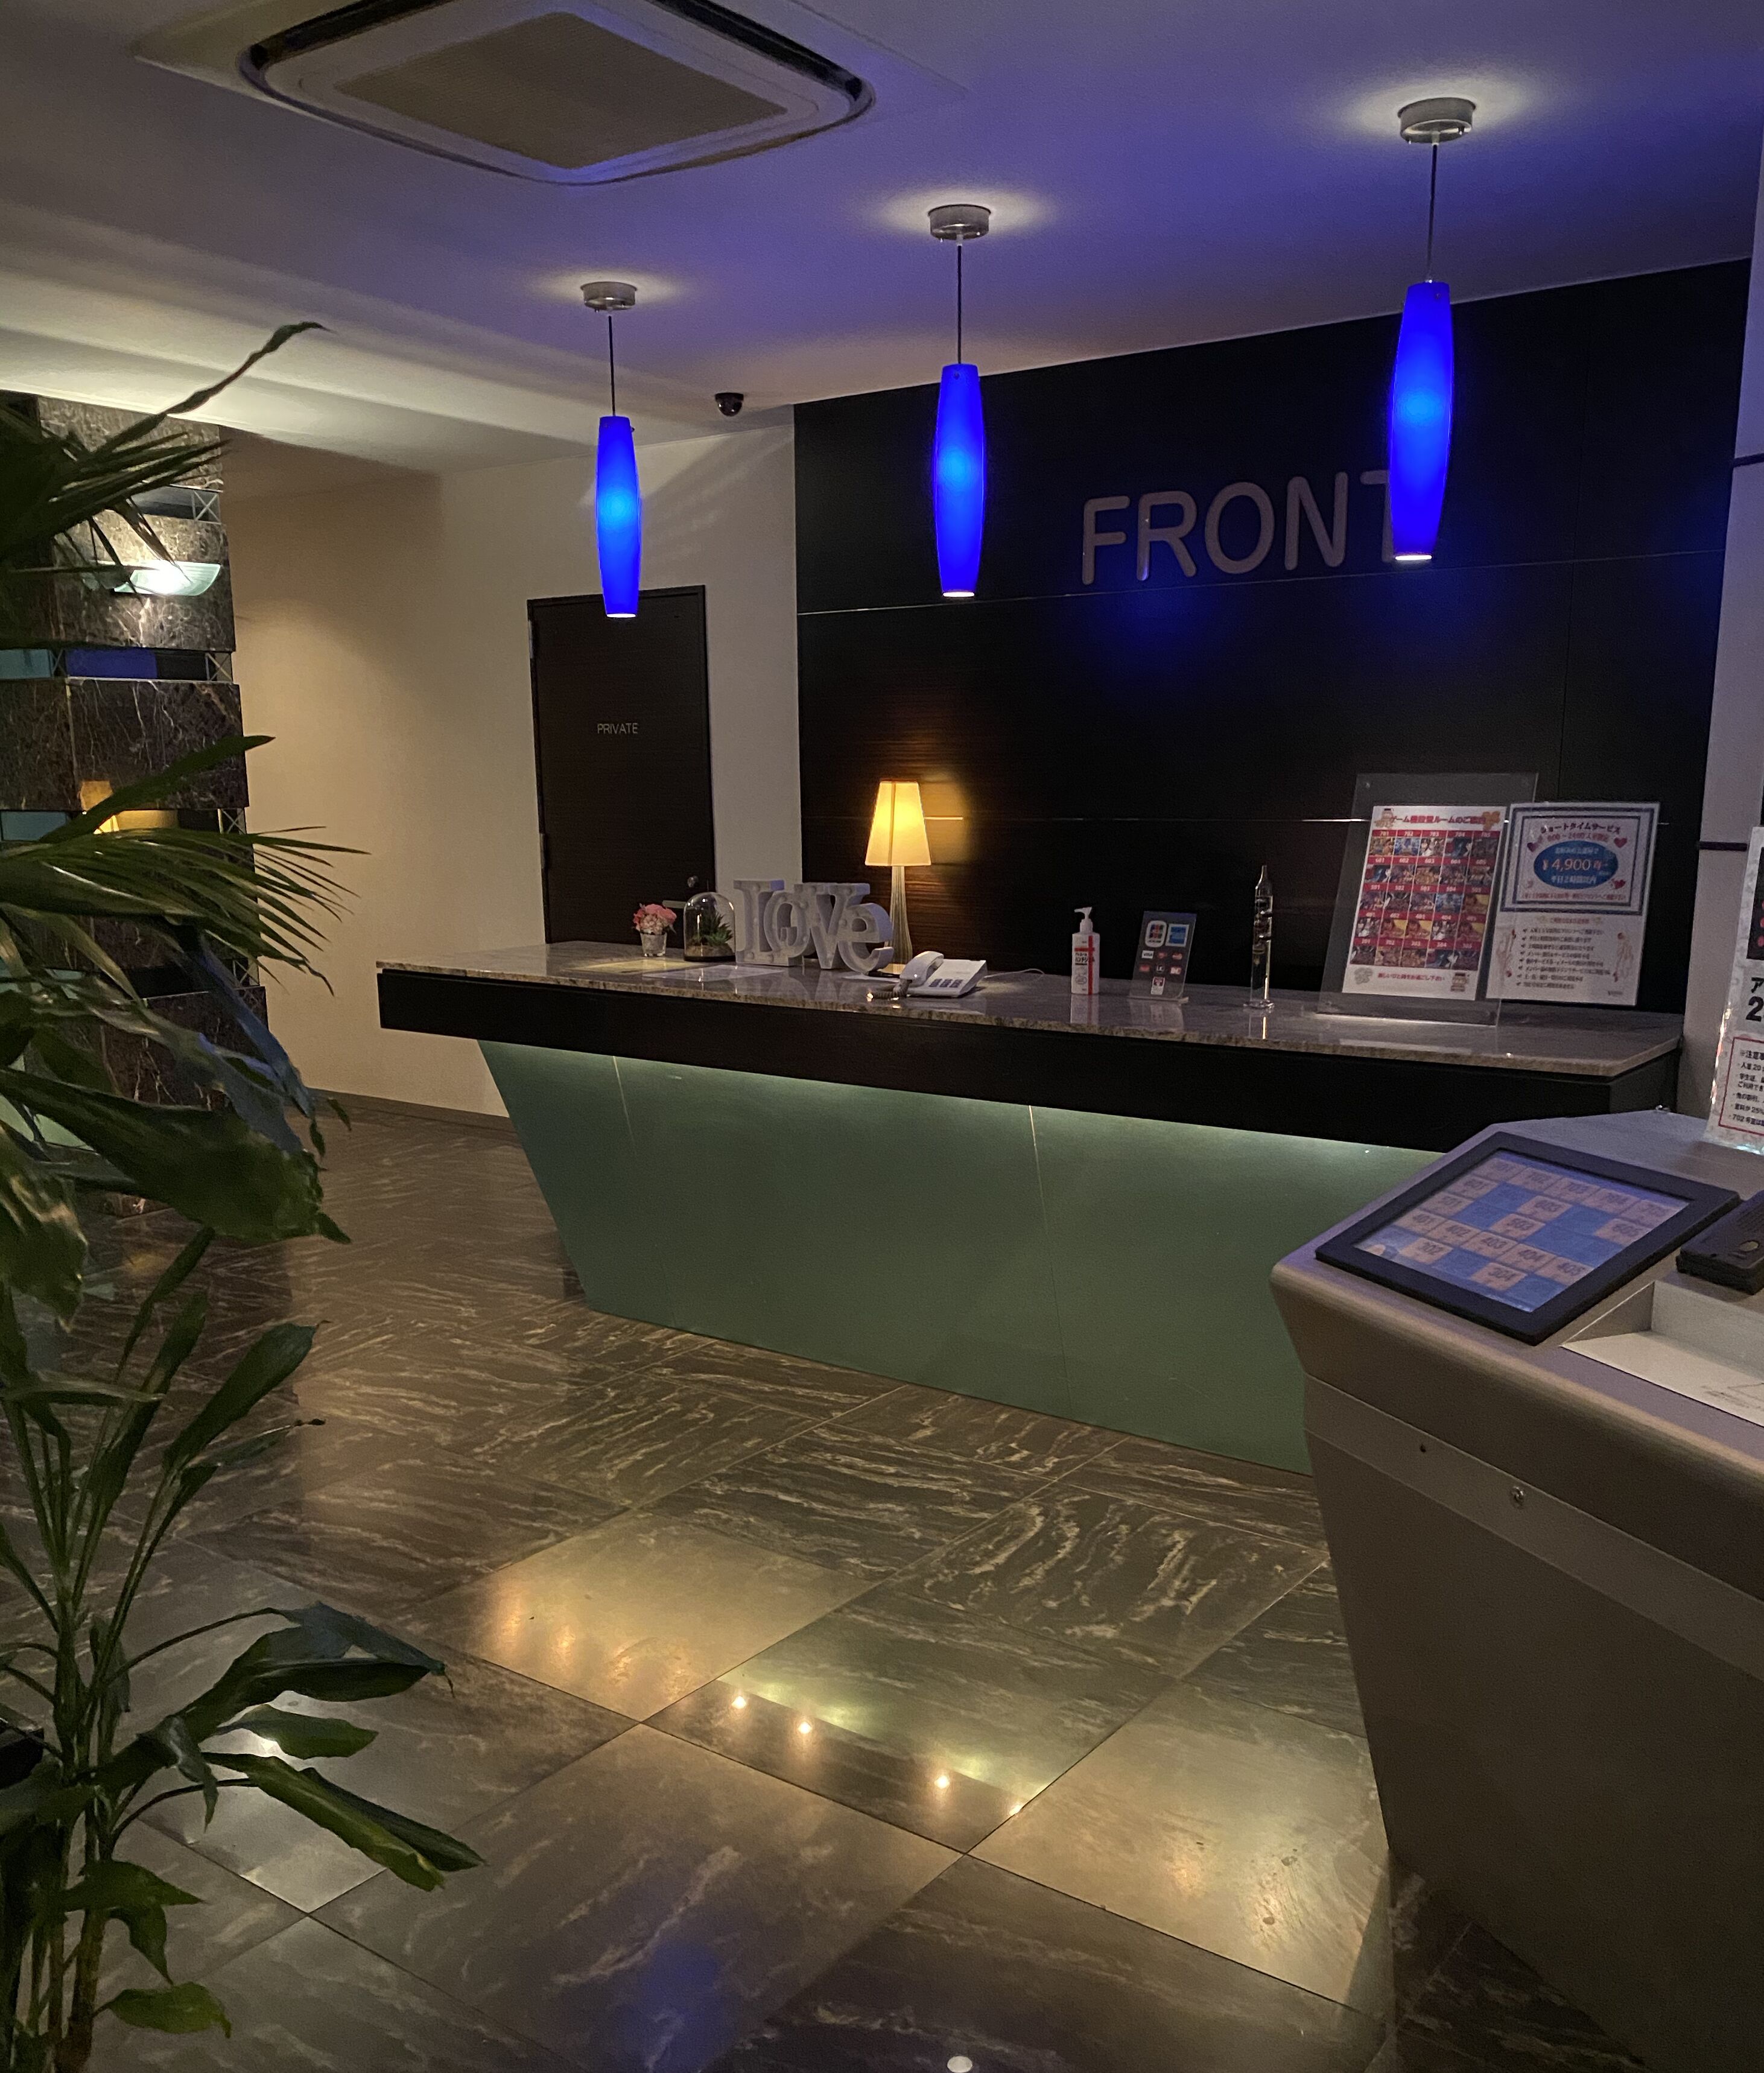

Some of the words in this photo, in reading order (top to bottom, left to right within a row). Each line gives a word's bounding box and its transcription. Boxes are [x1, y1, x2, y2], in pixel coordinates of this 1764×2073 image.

[597, 722, 638, 734] PRIVATE
[1410, 1212, 1435, 1224] 401
[1444, 1224, 1471, 1236] 402
[1480, 1236, 1508, 1249] 403
[1518, 1248, 1547, 1262] 404
[1556, 1262, 1587, 1277] 405
[1490, 1267, 1518, 1281] 304
